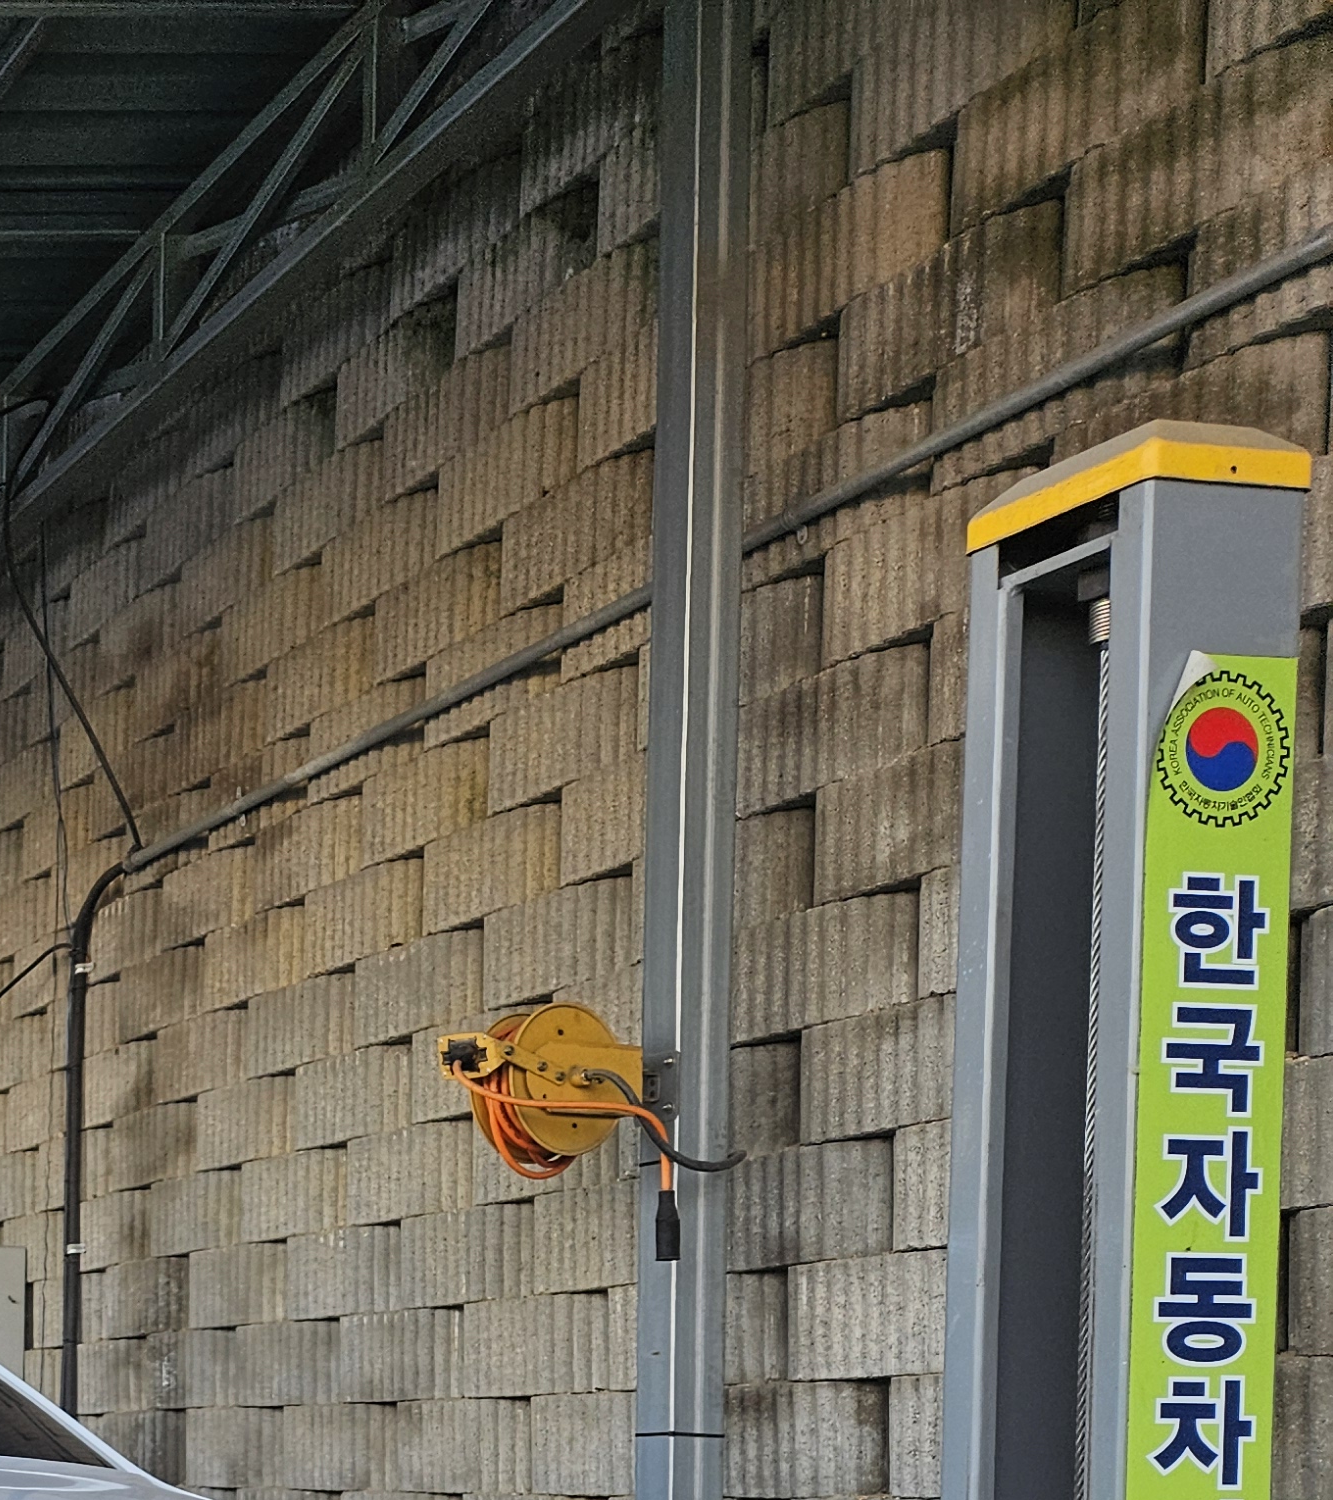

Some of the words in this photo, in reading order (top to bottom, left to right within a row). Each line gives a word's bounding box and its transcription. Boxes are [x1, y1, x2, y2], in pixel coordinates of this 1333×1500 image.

[1221, 687, 1235, 698] OF
[1235, 692, 1260, 714] AUTO
[1170, 688, 1220, 736] ASSOCIATION
[1168, 739, 1182, 776] KOREA
[1258, 710, 1276, 780] TECHNICIANS
